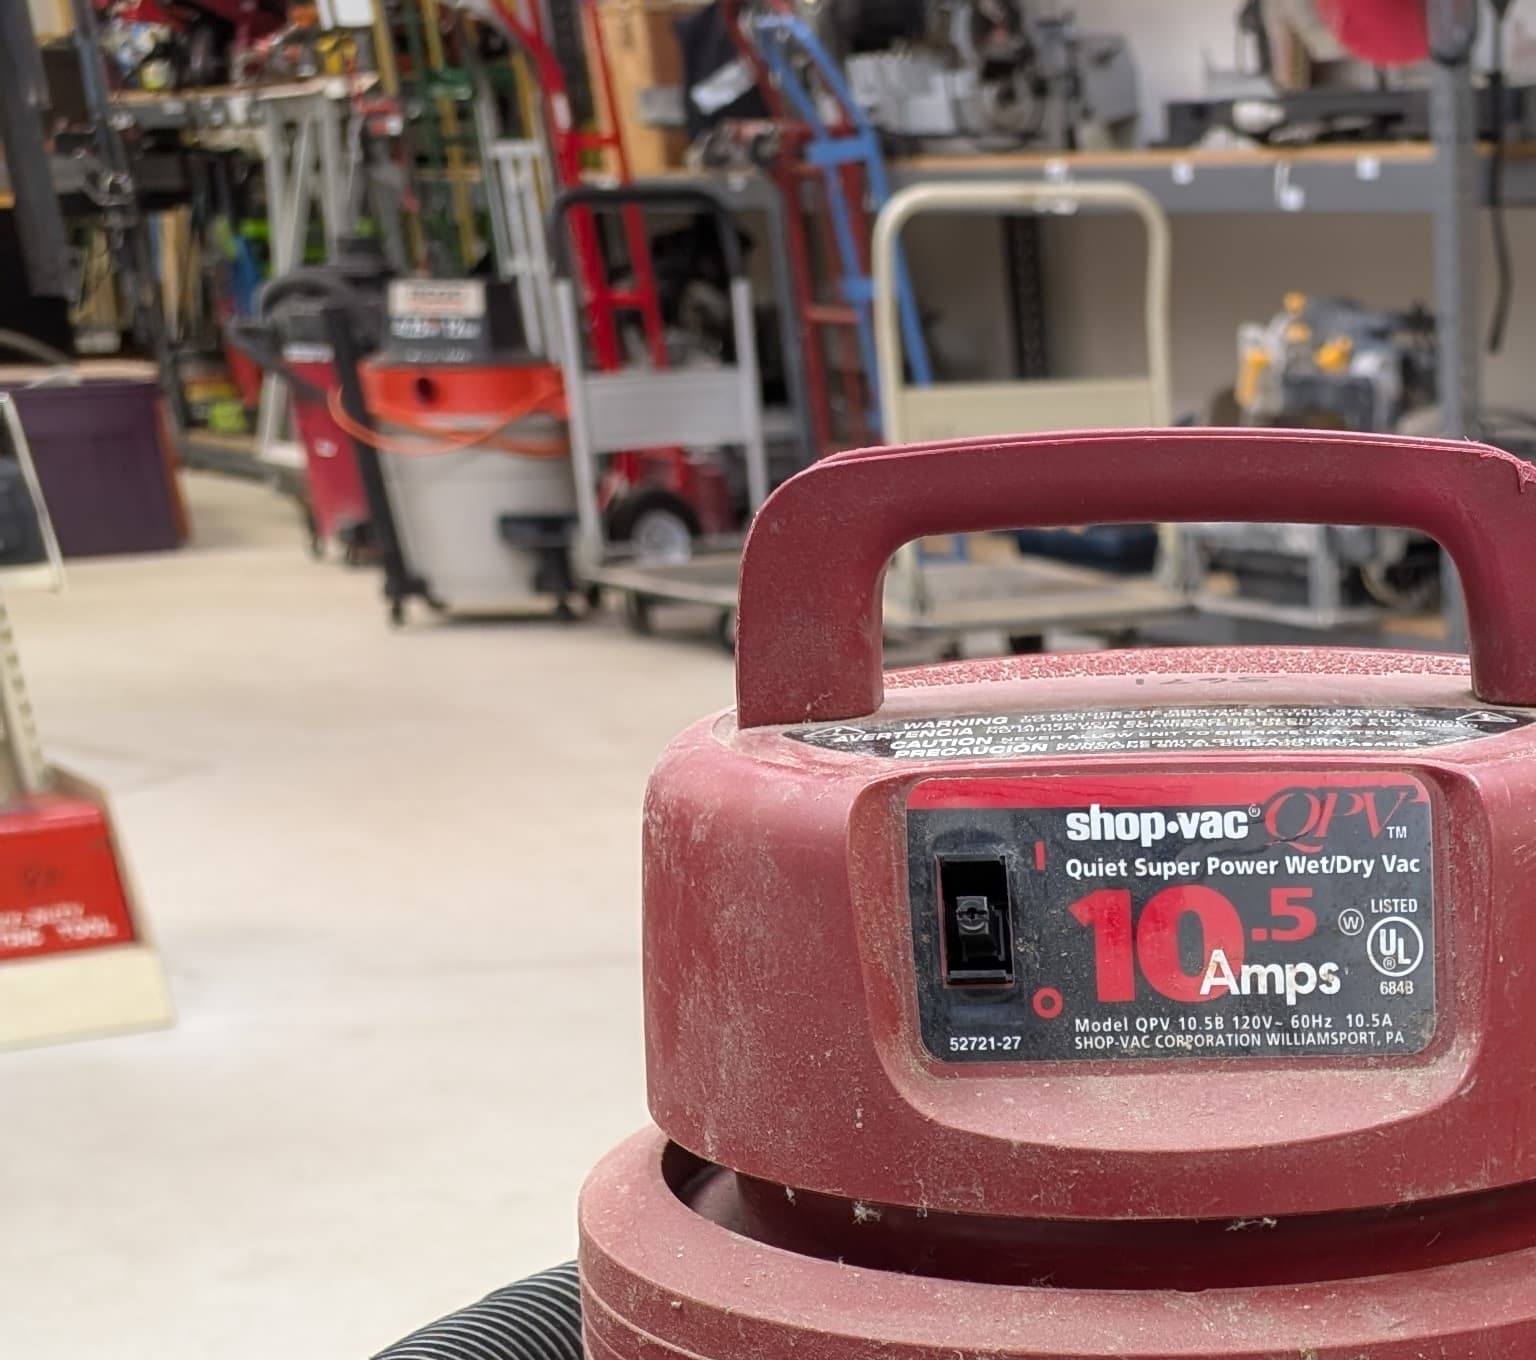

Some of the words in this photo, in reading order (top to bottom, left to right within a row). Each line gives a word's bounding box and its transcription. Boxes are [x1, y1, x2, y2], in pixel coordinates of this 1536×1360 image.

[904, 716, 1008, 730] WARNING
[832, 727, 973, 742] AVERTENCIA
[890, 736, 992, 749] CAUTION
[894, 742, 1048, 759] PRECAUCIÓN
[1263, 791, 1409, 853] QPV
[1066, 857, 1128, 880] Quiet
[1134, 857, 1201, 880] Super
[1207, 856, 1278, 875] Power
[1284, 855, 1375, 878] Wet/Dry
[1381, 855, 1420, 873] Vac
[1370, 898, 1418, 913] LISTED
[1200, 948, 1340, 1005] Amps
[1074, 1017, 1129, 1033] Model
[1135, 1016, 1170, 1033] QPV
[1179, 1016, 1224, 1030] 10.5B
[1291, 1014, 1333, 1029] 60Hz
[1346, 1013, 1392, 1028] 10.5A
[950, 1035, 1021, 1051] 52721-27
[1074, 1034, 1150, 1050] SHOP-VAC
[1155, 1033, 1260, 1049] CORPORATION
[1266, 1031, 1381, 1046] WILLIAMSPORT,
[1386, 1031, 1405, 1045] PA
